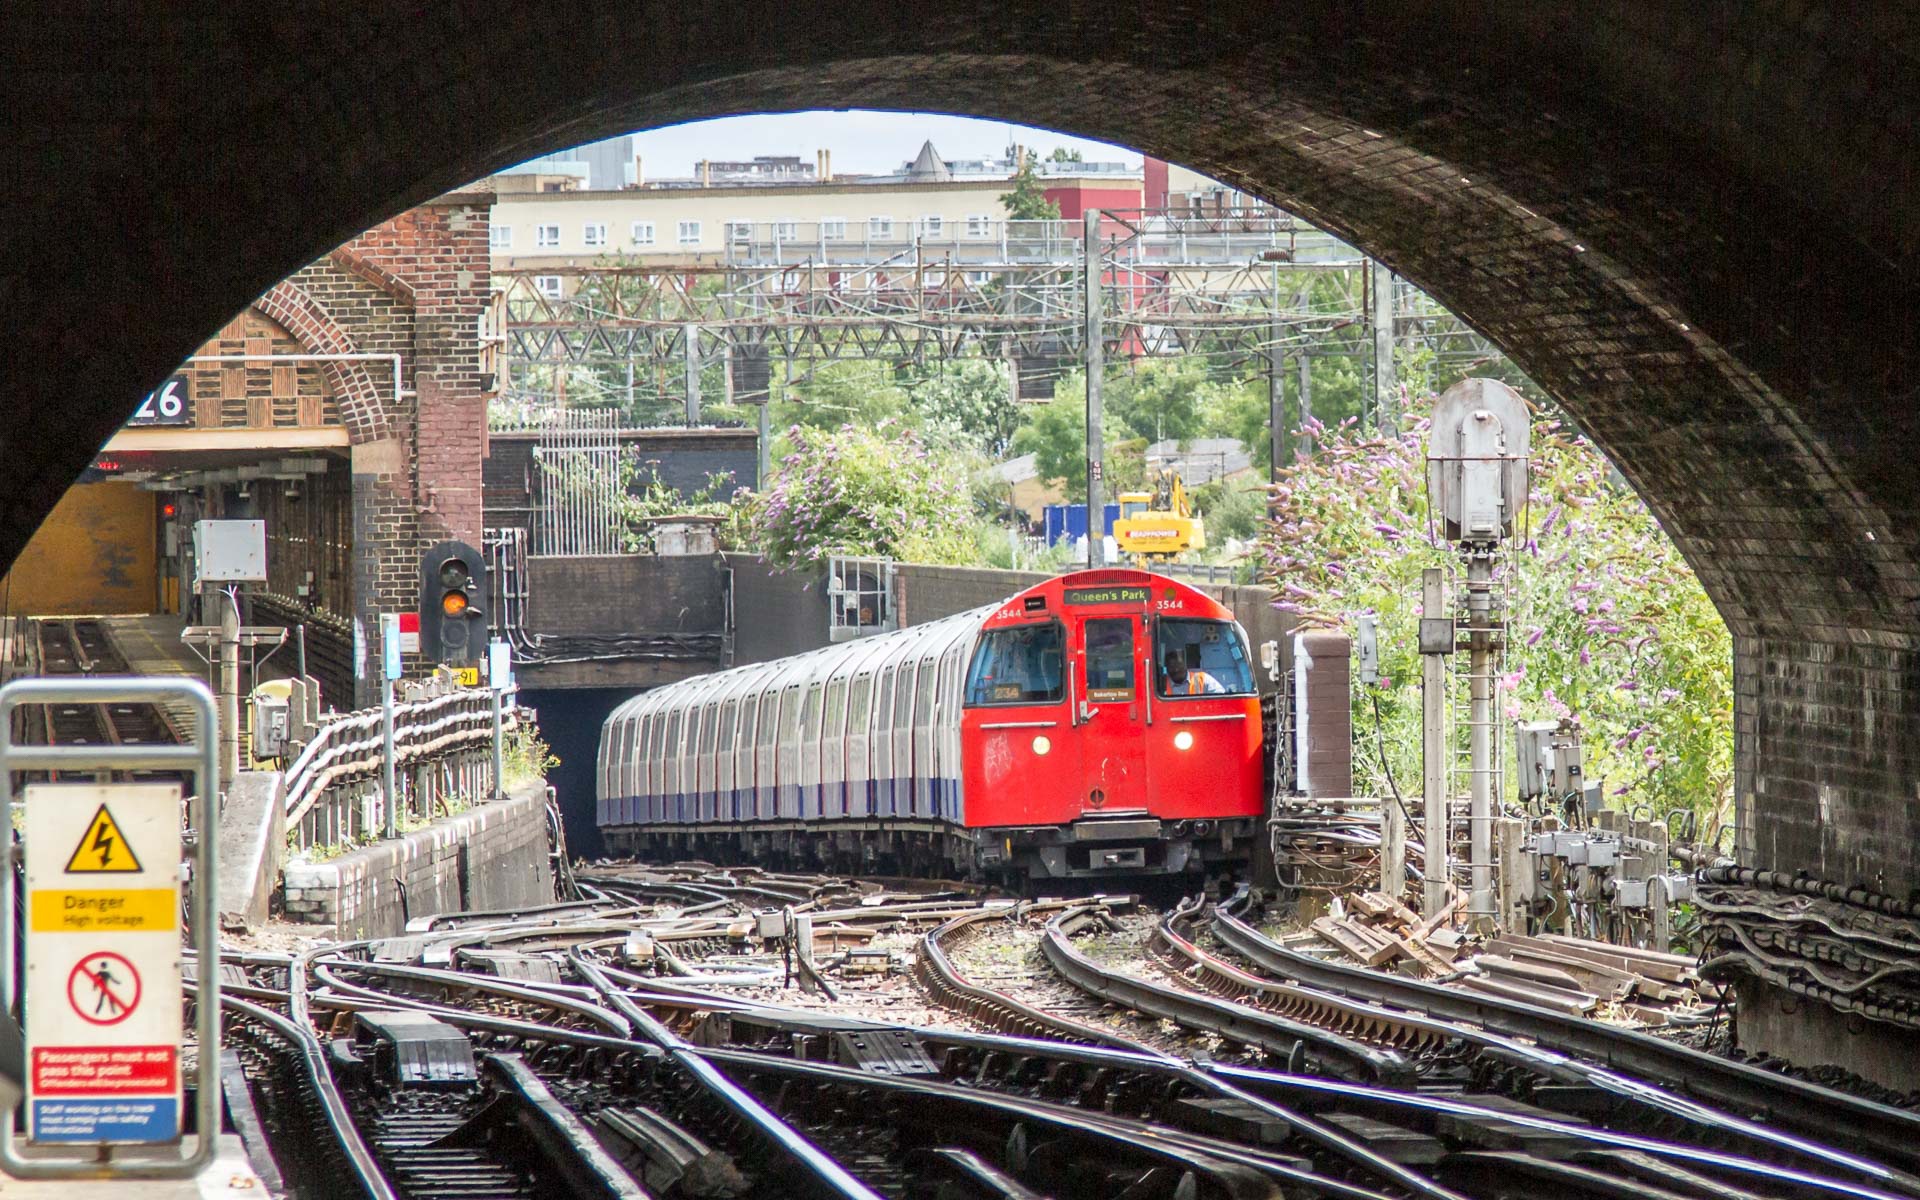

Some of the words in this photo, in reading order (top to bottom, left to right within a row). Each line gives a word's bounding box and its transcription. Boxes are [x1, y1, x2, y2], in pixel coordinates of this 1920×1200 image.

[1072, 591, 1118, 602] Queen's
[1122, 589, 1145, 601] Park
[1157, 600, 1183, 610] 3544
[997, 609, 1021, 620] 3544
[64, 895, 125, 912] Danger
[64, 915, 93, 928] High
[97, 914, 144, 927] voltage
[39, 1051, 110, 1065] Passengers
[111, 1051, 144, 1062] must
[145, 1050, 169, 1062] not
[39, 1066, 69, 1079] pass
[70, 1065, 96, 1076] this
[97, 1064, 132, 1079] point
[41, 1104, 64, 1114] Staff
[65, 1105, 100, 1115] working
[115, 1104, 130, 1113] the
[41, 1116, 64, 1124] must
[120, 1114, 150, 1126] safety
